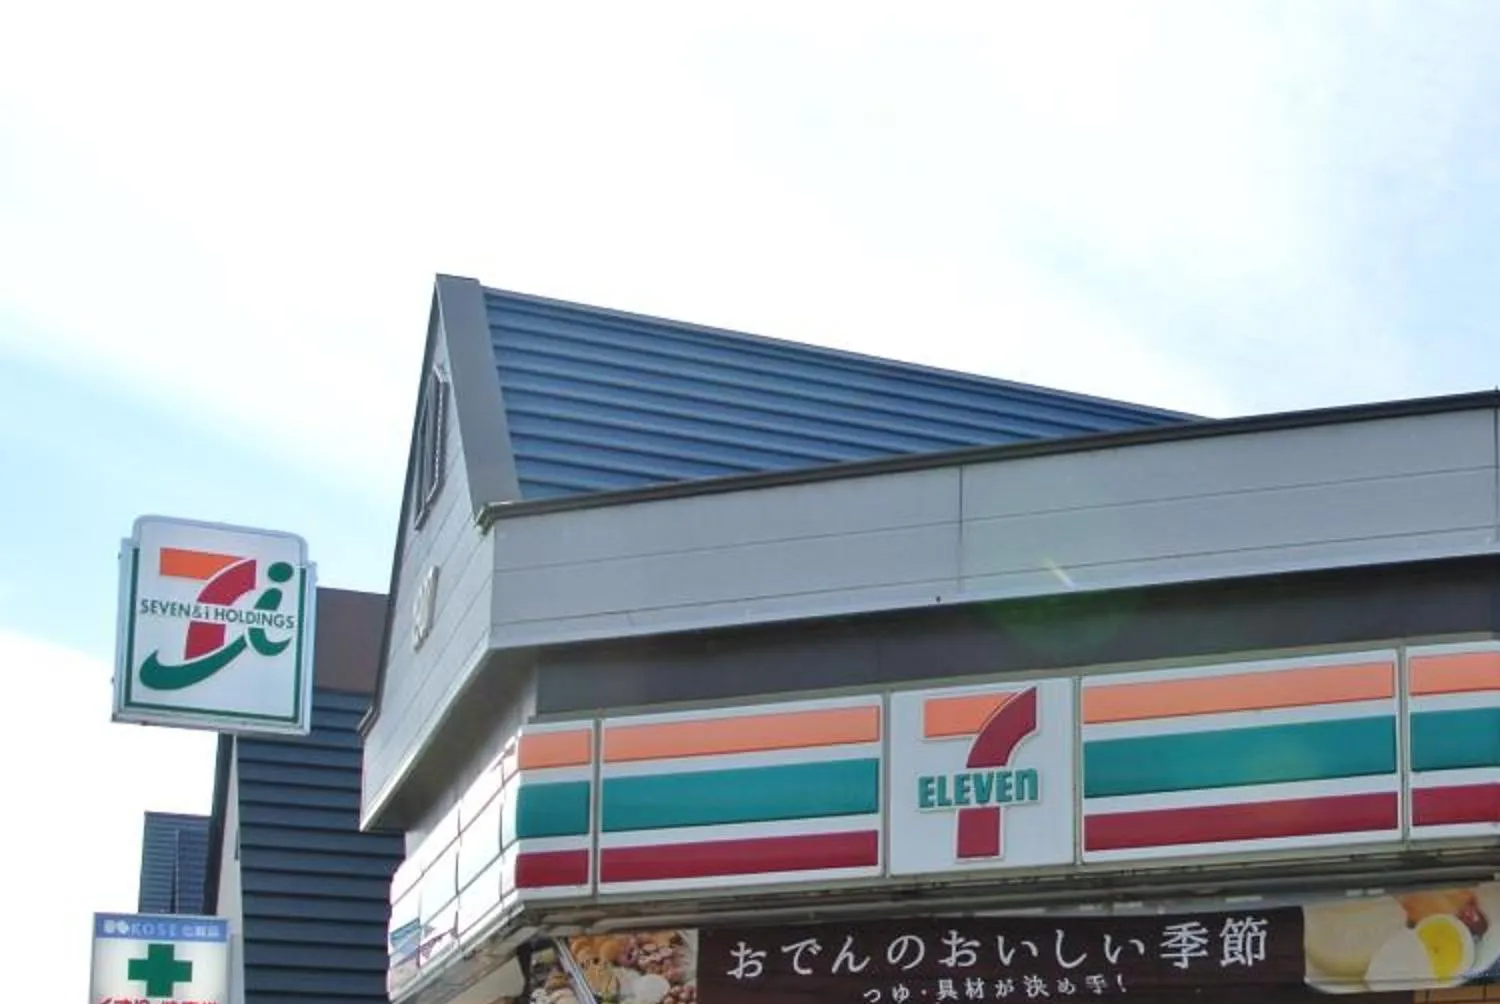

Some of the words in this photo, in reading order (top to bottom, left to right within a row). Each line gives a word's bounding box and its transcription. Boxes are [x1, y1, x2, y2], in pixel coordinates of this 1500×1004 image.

[214, 607, 295, 630] HOLDINGS
[727, 916, 1268, 979] おでんのおいしい季節
